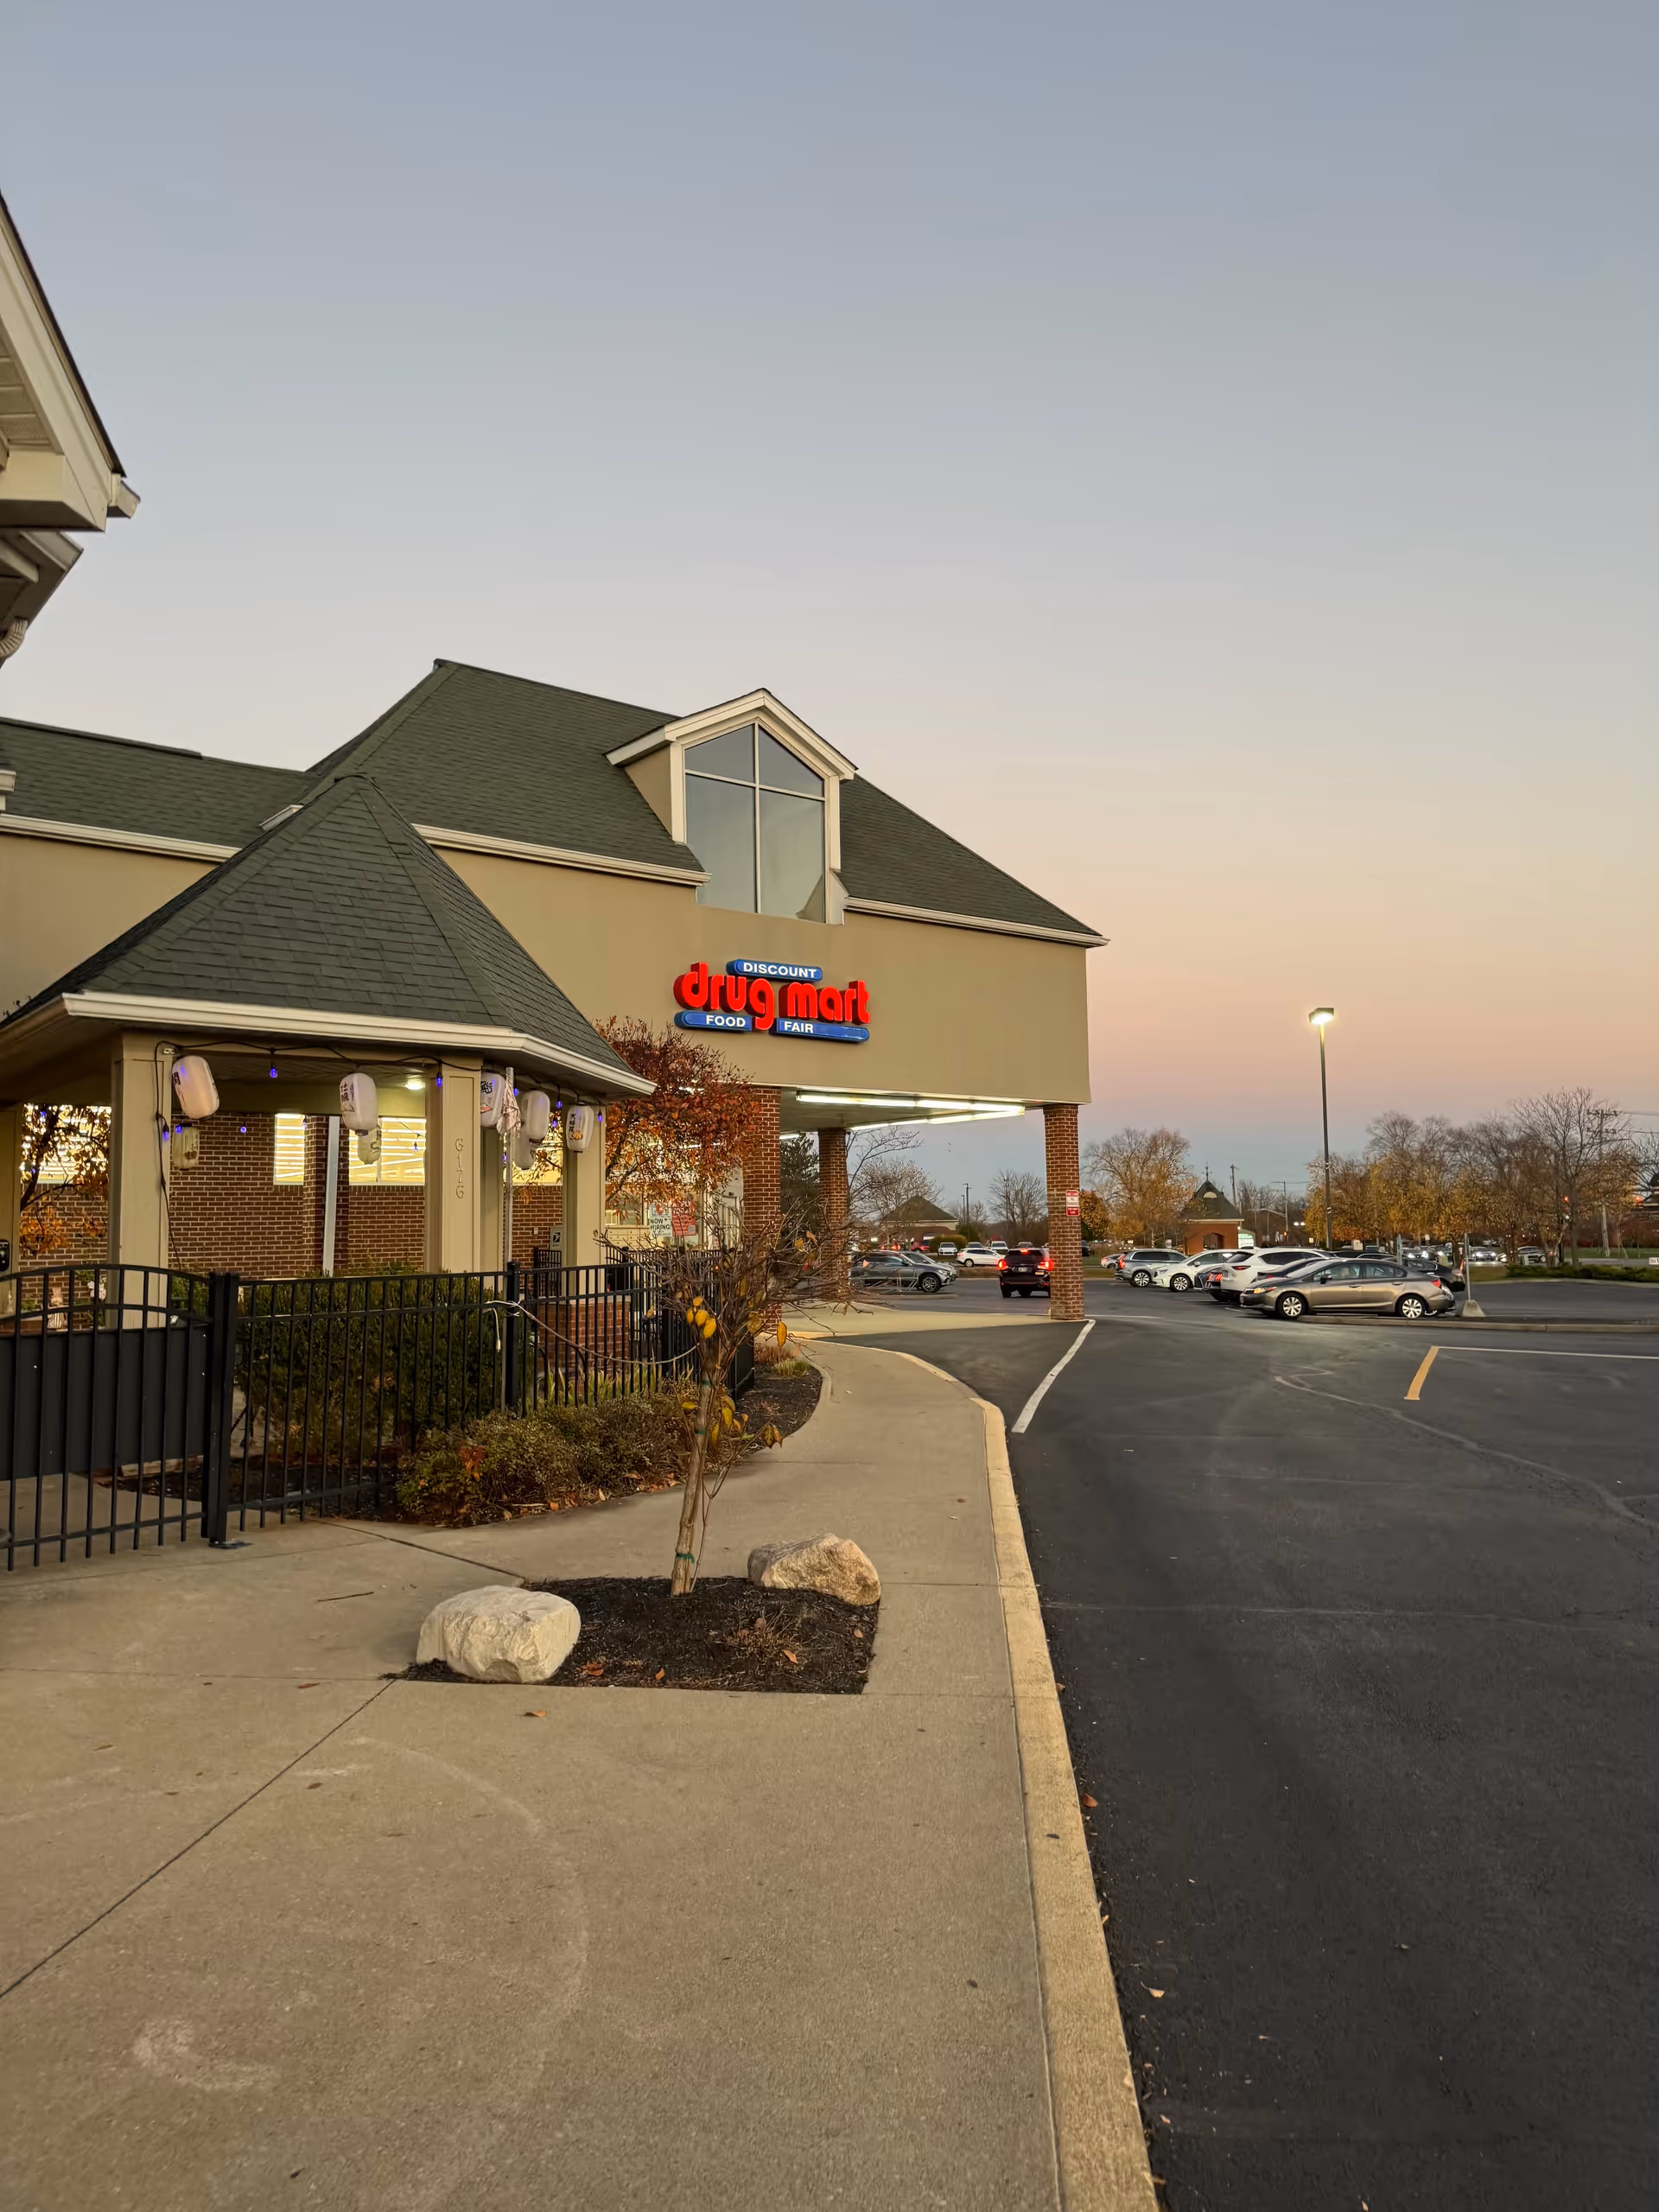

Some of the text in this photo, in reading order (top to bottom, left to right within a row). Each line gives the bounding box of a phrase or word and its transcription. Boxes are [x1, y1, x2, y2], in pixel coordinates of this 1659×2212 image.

[742, 962, 817, 978] DISCOUNT
[679, 962, 870, 1031] drug mart
[706, 1014, 814, 1033] FOOD FAIR
